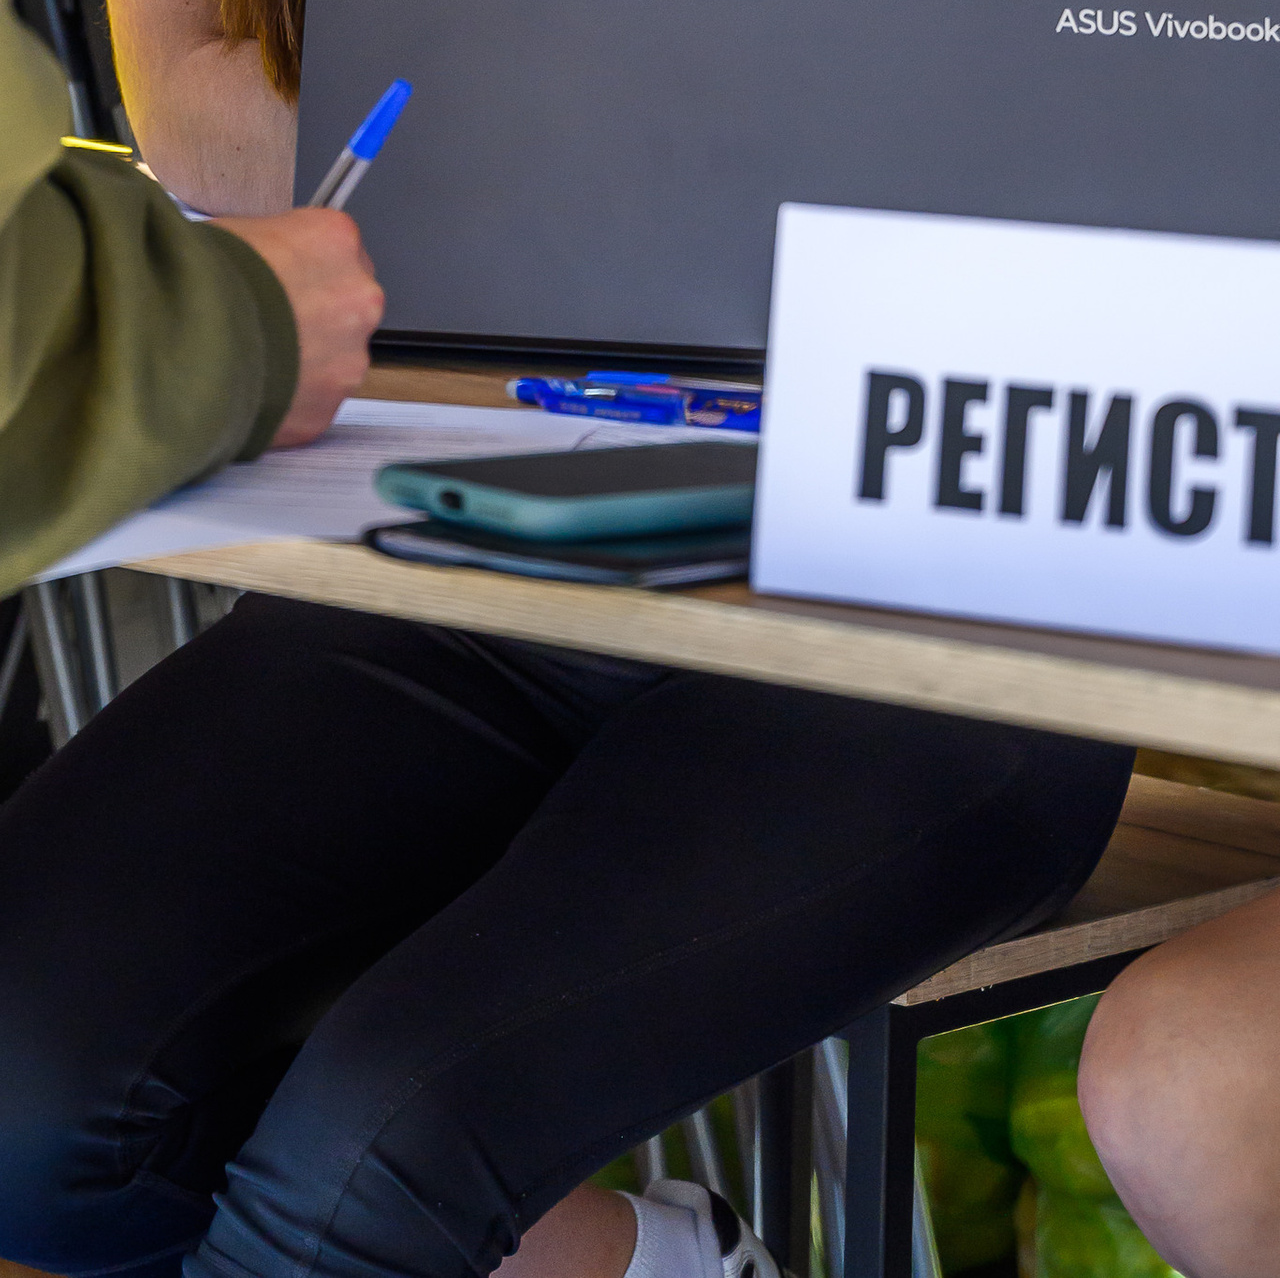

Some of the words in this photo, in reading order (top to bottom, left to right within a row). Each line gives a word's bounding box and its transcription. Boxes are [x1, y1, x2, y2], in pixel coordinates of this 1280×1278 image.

[1055, 8, 1138, 36] ASUS
[1144, 11, 1280, 42] Vivobook
[855, 367, 1280, 549] РЕГИСТ
